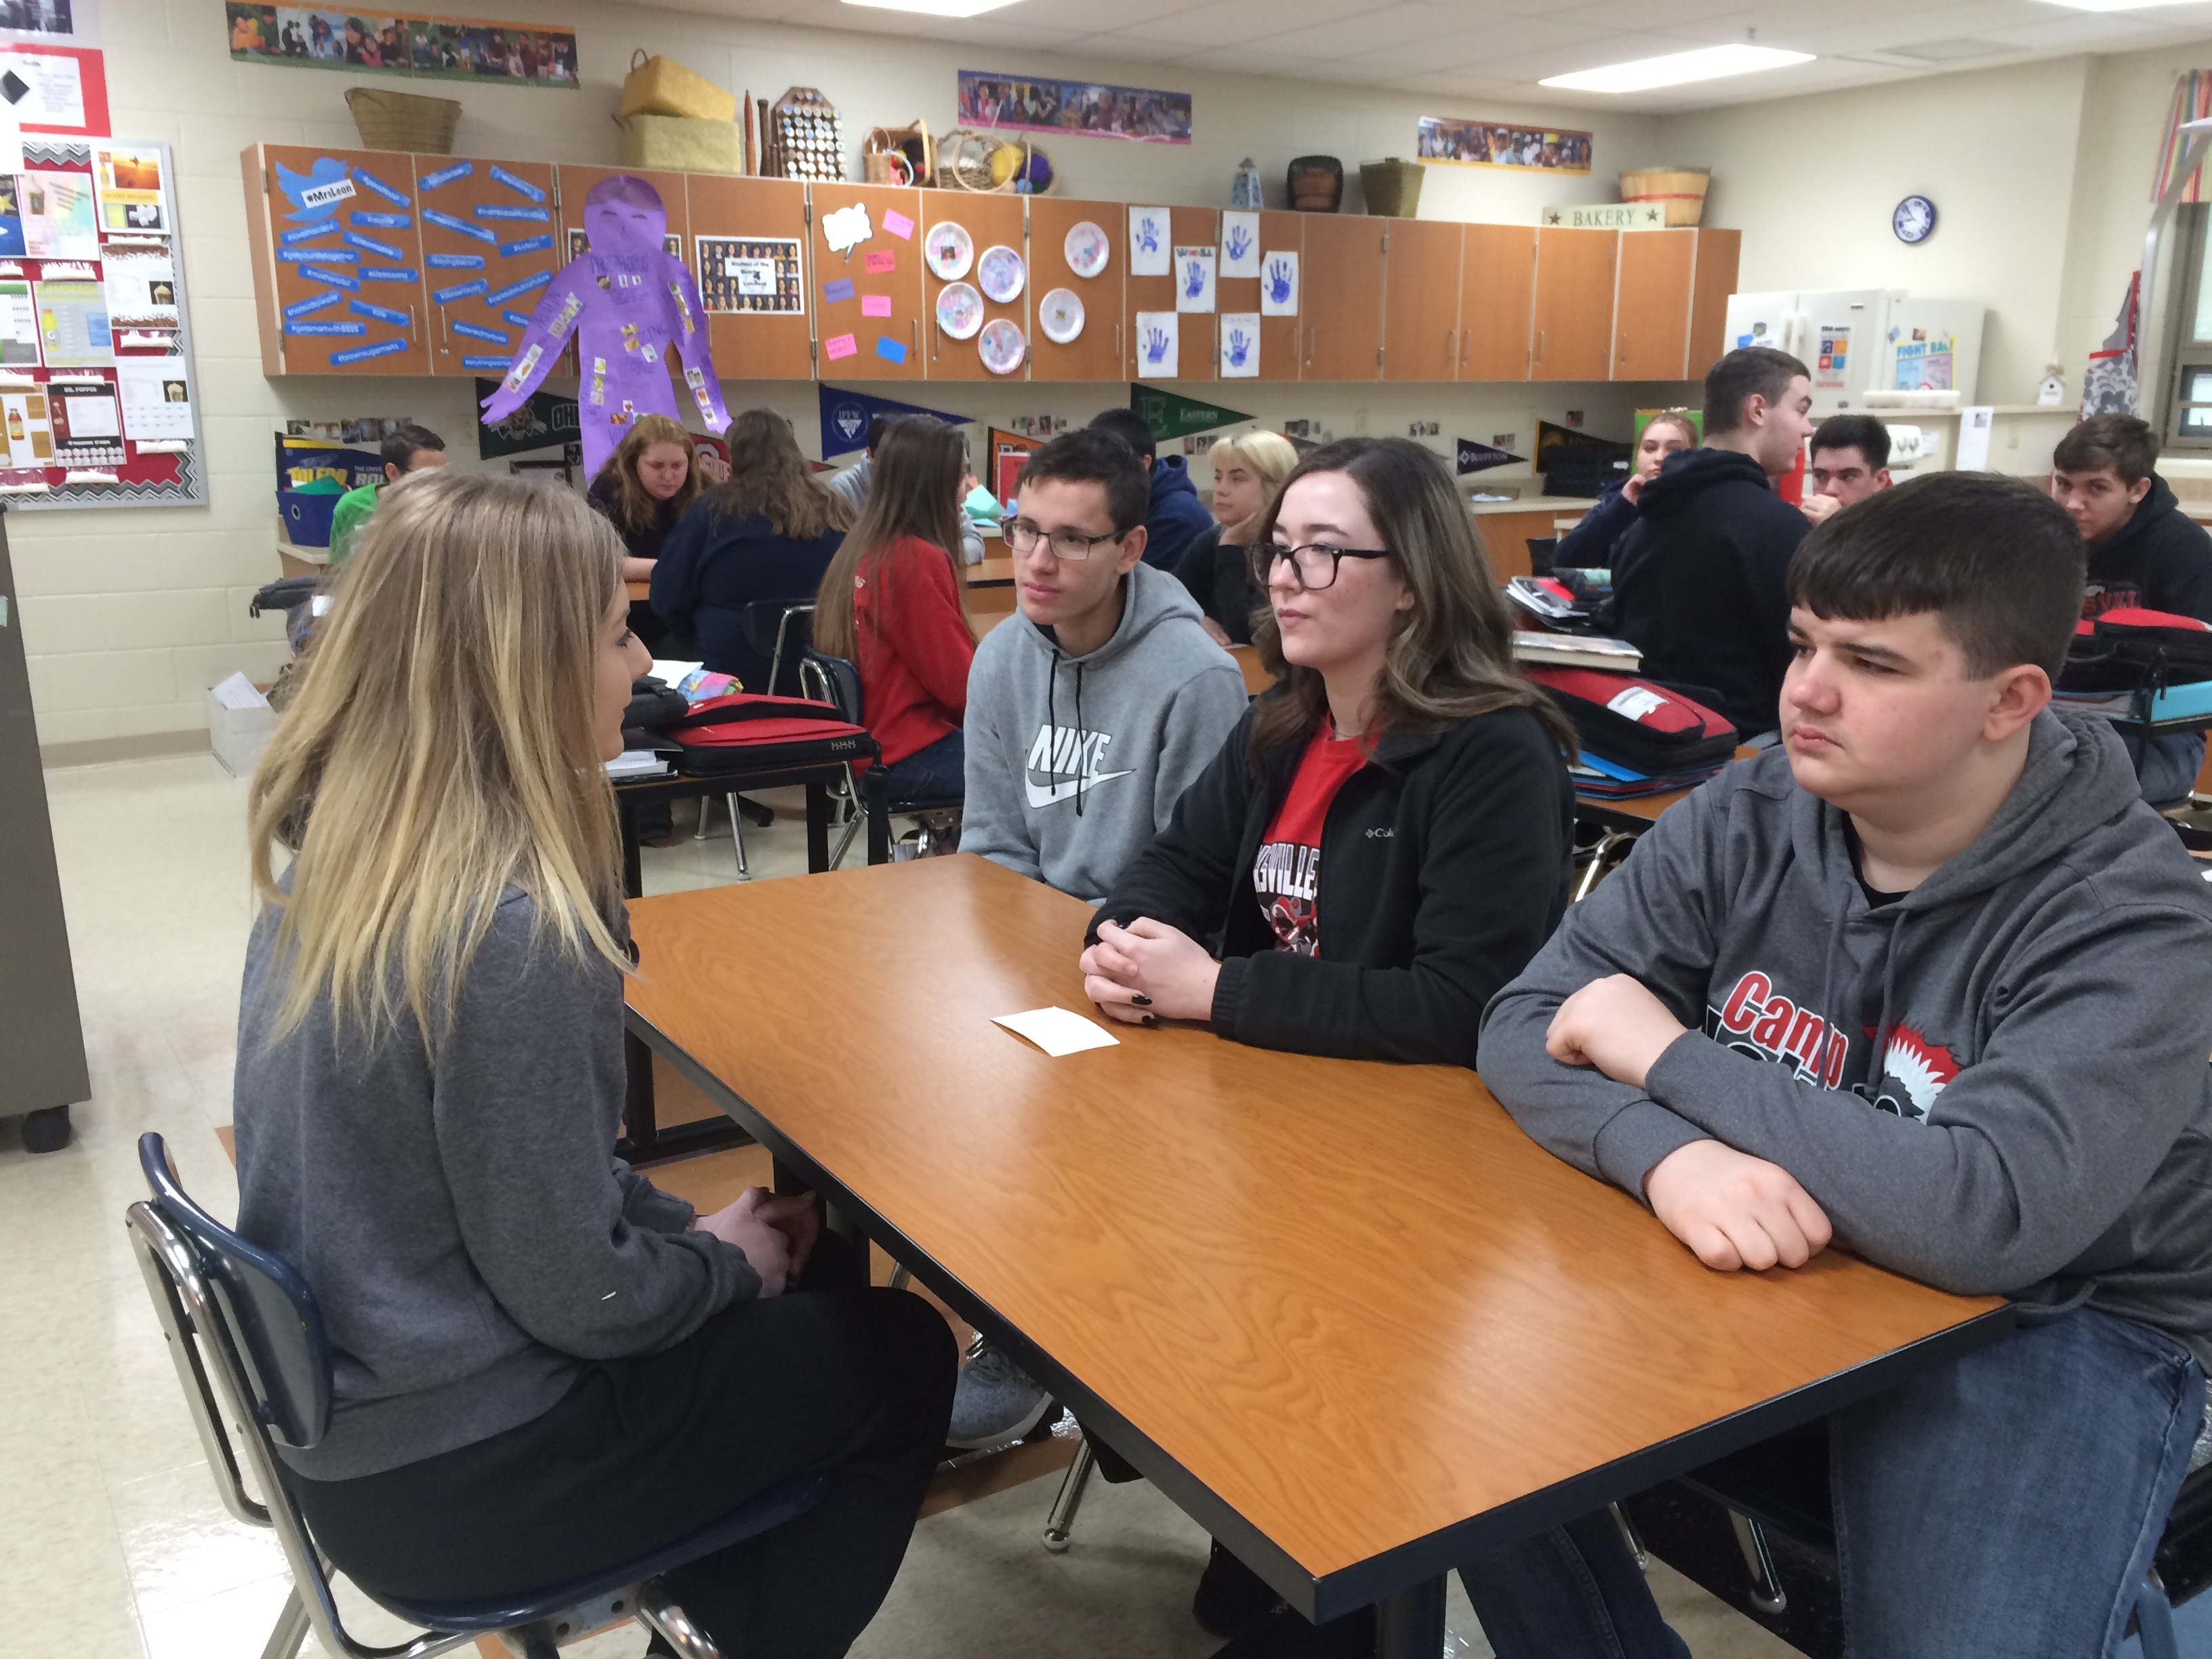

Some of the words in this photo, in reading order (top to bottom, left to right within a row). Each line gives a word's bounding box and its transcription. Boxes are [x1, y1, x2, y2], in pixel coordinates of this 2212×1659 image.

[306, 184, 353, 203] #MrsLeon
[1573, 208, 1635, 226] BAKERY
[1897, 342, 1927, 357] FIGHT
[1180, 408, 1218, 419] EASTERN
[1028, 724, 1113, 777] NIKE
[1721, 970, 1849, 1092] Camp
